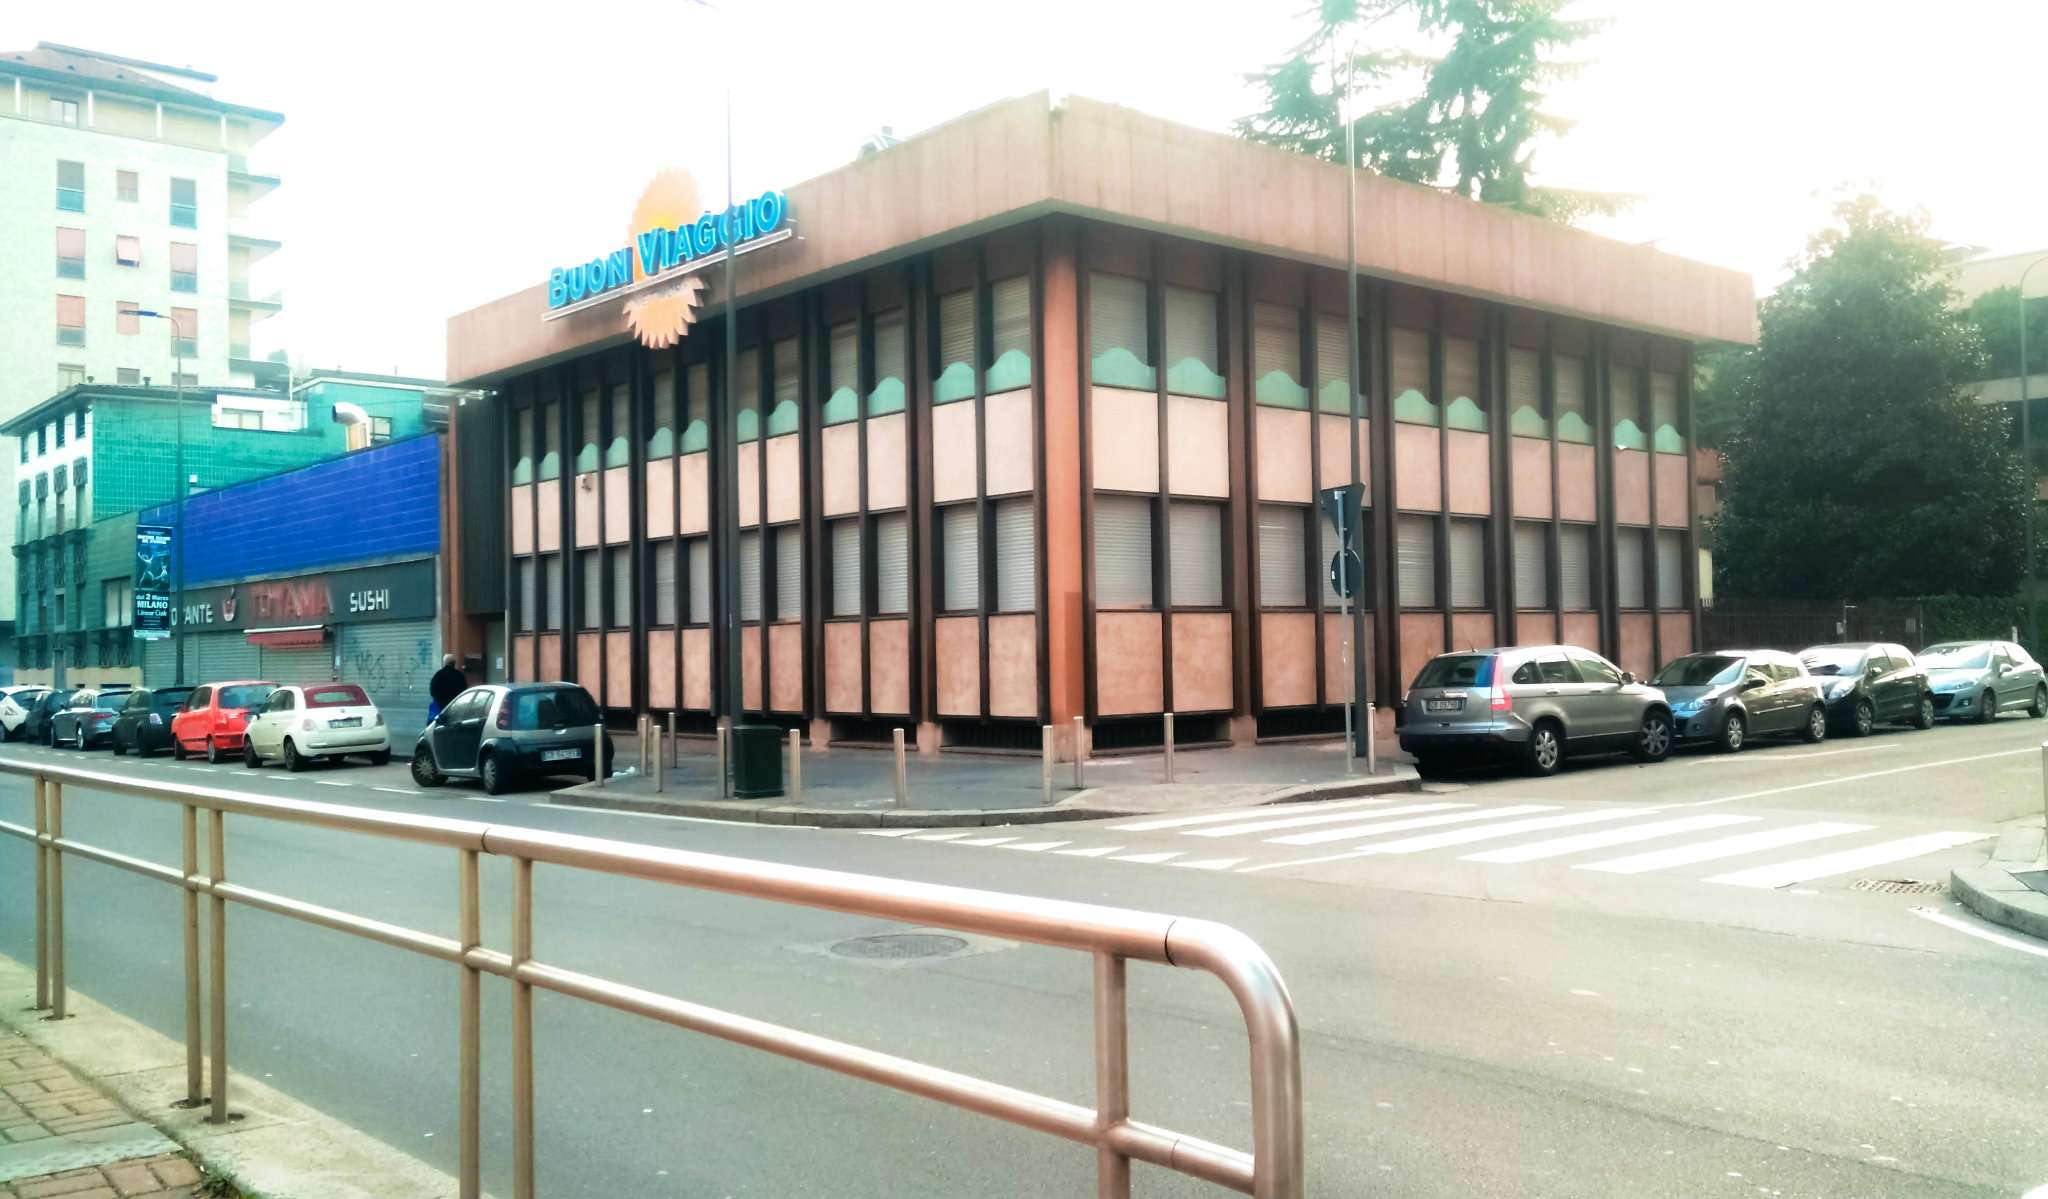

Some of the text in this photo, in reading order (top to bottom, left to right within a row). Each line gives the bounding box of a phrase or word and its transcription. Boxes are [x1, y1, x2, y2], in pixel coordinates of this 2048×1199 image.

[548, 189, 787, 309] BUON VIAGGIO
[136, 600, 168, 609] MILANO
[350, 589, 389, 612] SUSHI
